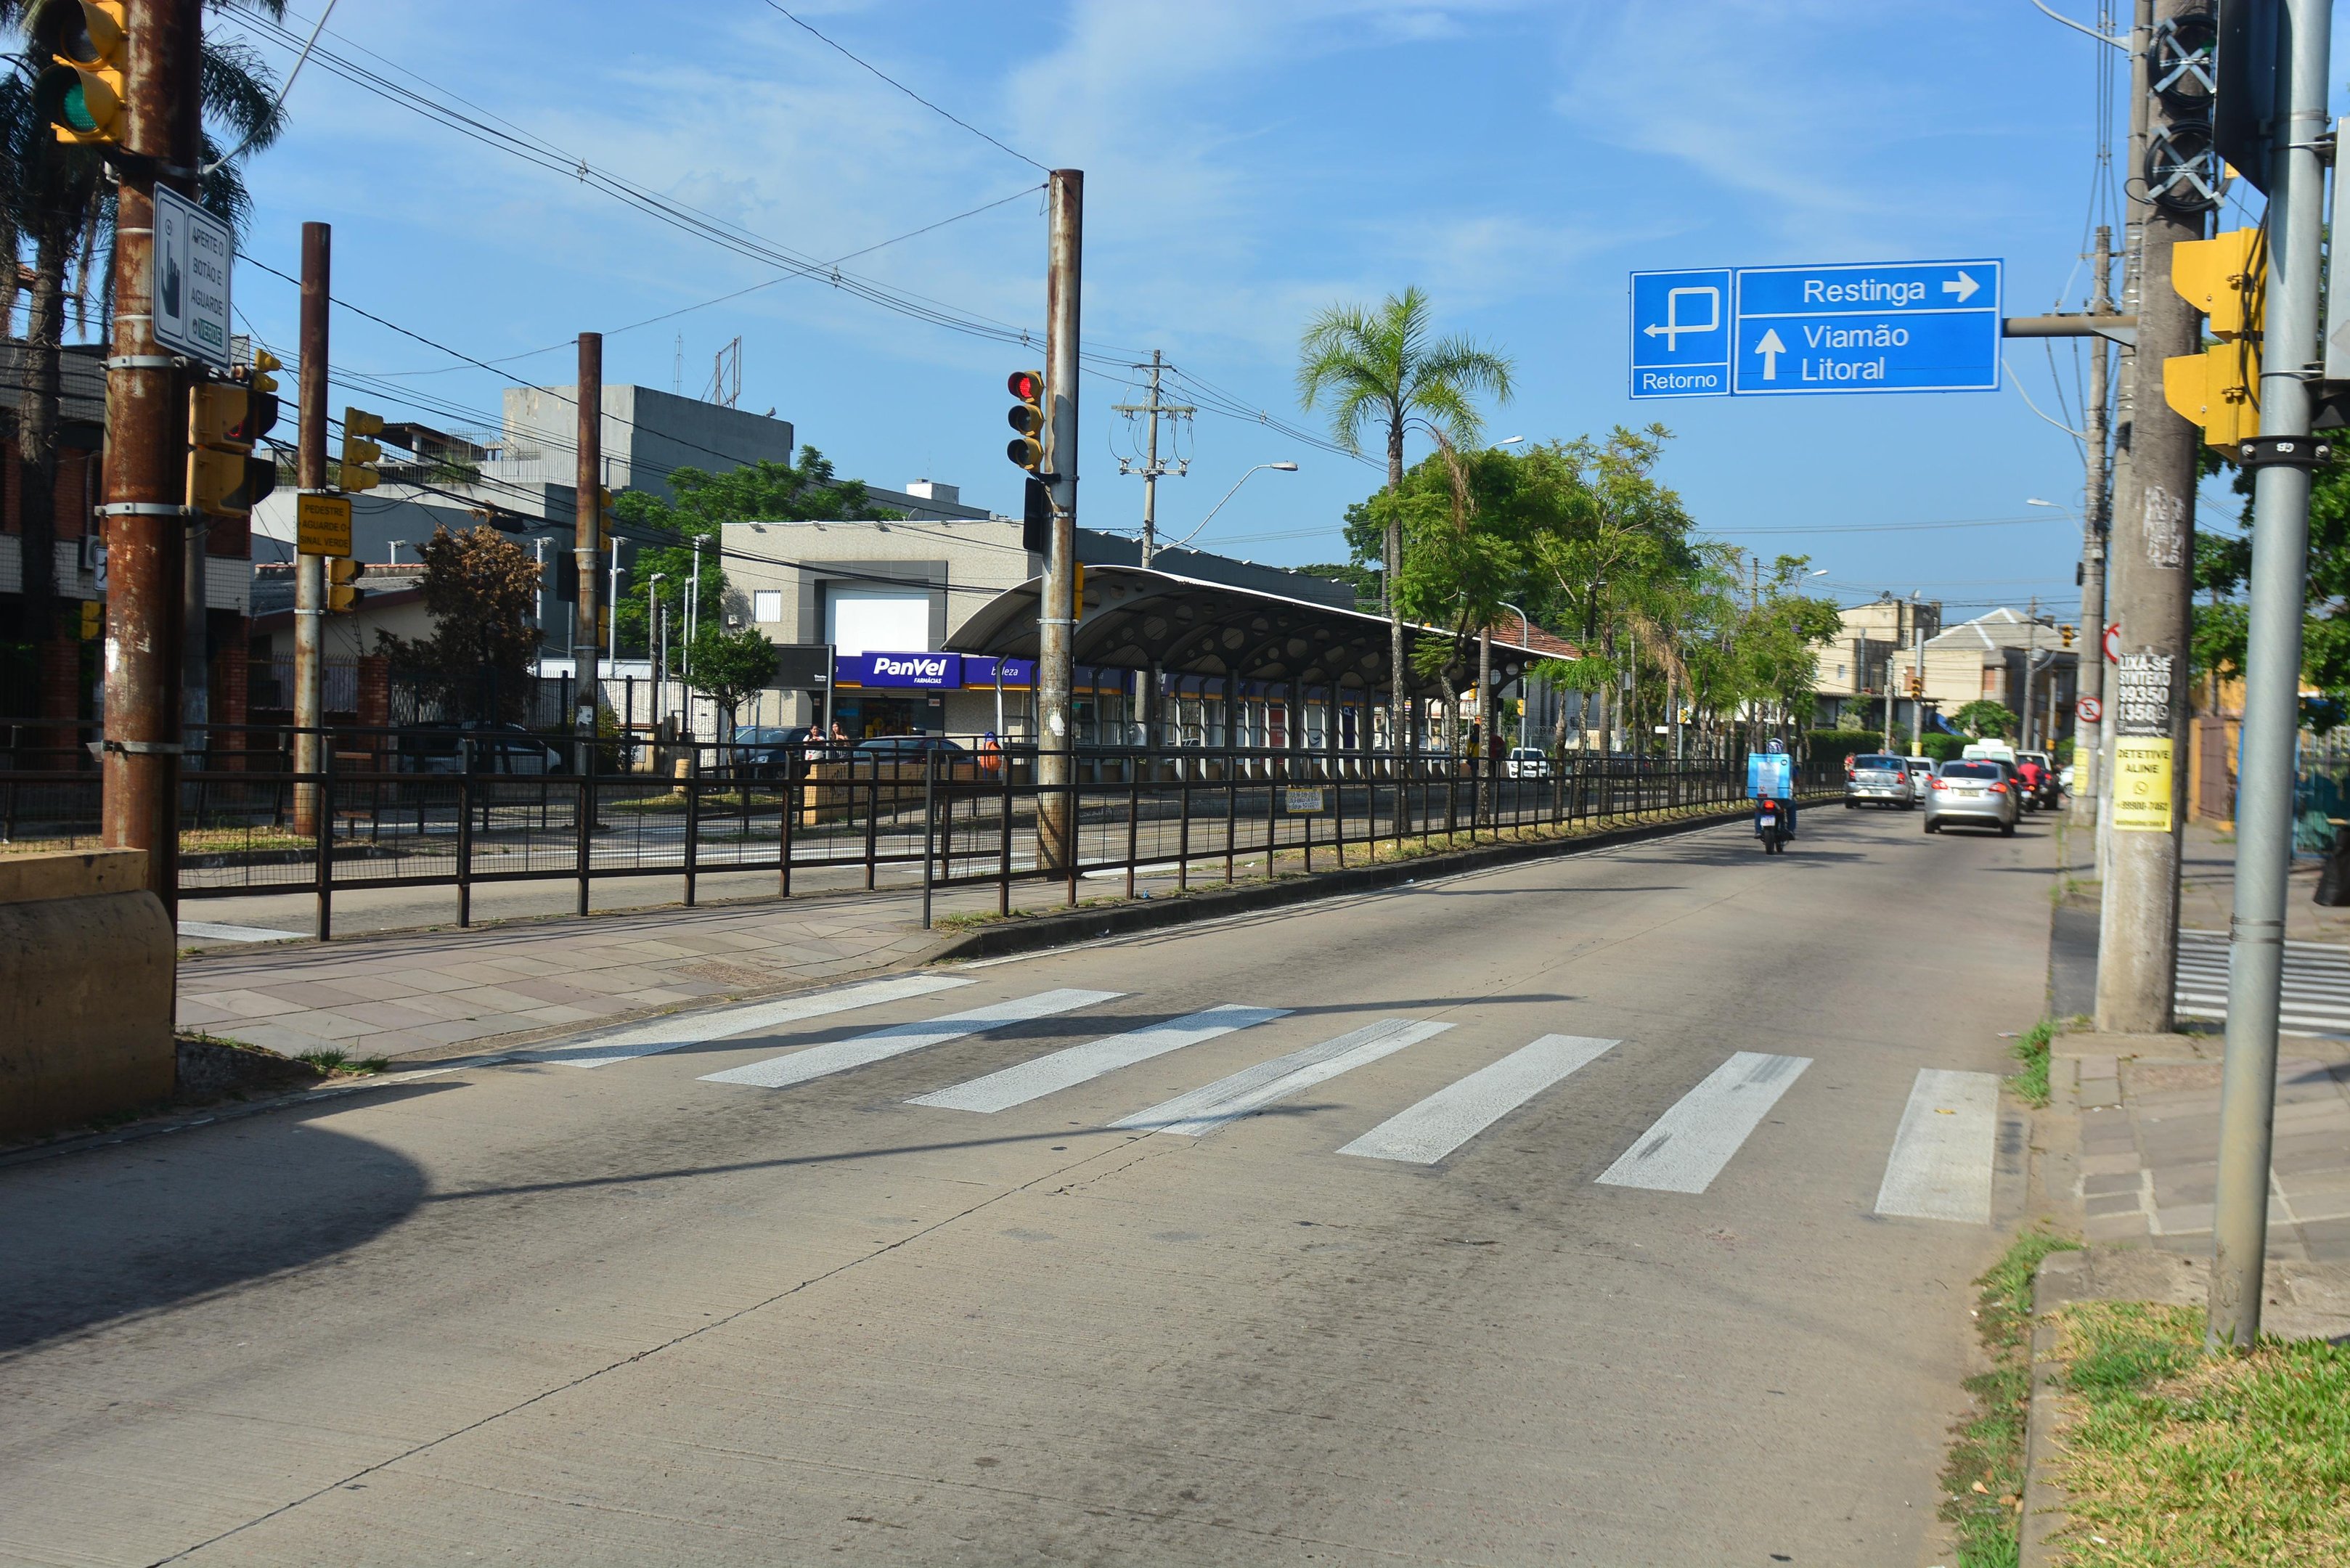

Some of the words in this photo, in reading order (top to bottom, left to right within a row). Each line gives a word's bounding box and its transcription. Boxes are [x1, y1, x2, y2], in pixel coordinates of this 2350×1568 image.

[192, 226, 218, 253] APERTE
[219, 241, 224, 257] O
[193, 257, 216, 282] BOTÃO
[217, 270, 222, 286] E
[1803, 279, 1926, 306] Restinga
[191, 287, 223, 317] AGUARDE
[199, 319, 222, 346] VERDE
[1803, 324, 1910, 348] Viamão
[1802, 356, 1886, 381] Litoral
[1643, 373, 1718, 390] Retorno
[304, 505, 344, 516] PEDESTRE
[302, 520, 339, 531] AGUARDE
[340, 523, 346, 532] O
[300, 535, 322, 546] SINAL
[325, 538, 348, 548] VERDE
[873, 658, 947, 676] PanVel
[990, 666, 1019, 677] bleza
[2119, 656, 2172, 671] LIXA-SE
[2118, 685, 2169, 704] 99350
[2118, 703, 2158, 722] 1358
[2118, 749, 2171, 759] DETETIVE
[2126, 764, 2161, 773] ALINE
